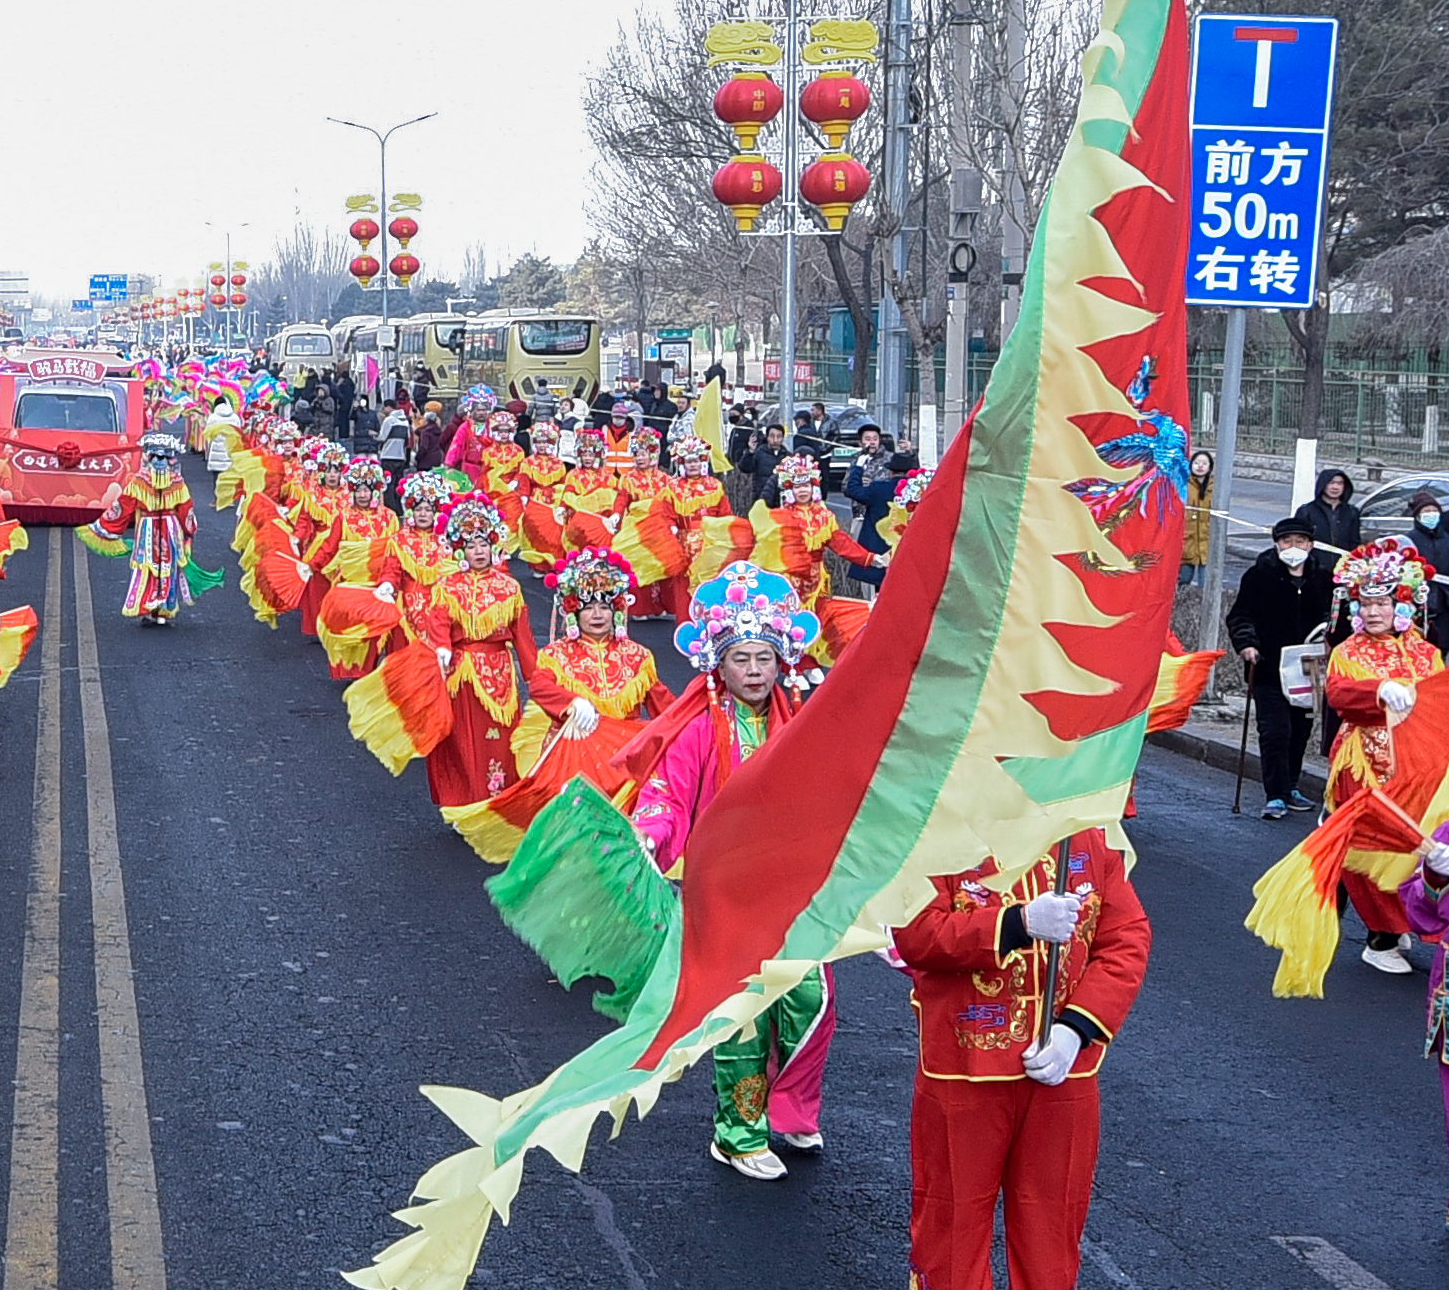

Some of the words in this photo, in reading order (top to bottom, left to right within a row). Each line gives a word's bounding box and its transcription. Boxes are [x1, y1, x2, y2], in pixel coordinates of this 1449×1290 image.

[1204, 139, 1309, 186] 前方
[1198, 191, 1299, 240] 50m
[1194, 245, 1301, 295] 右转
